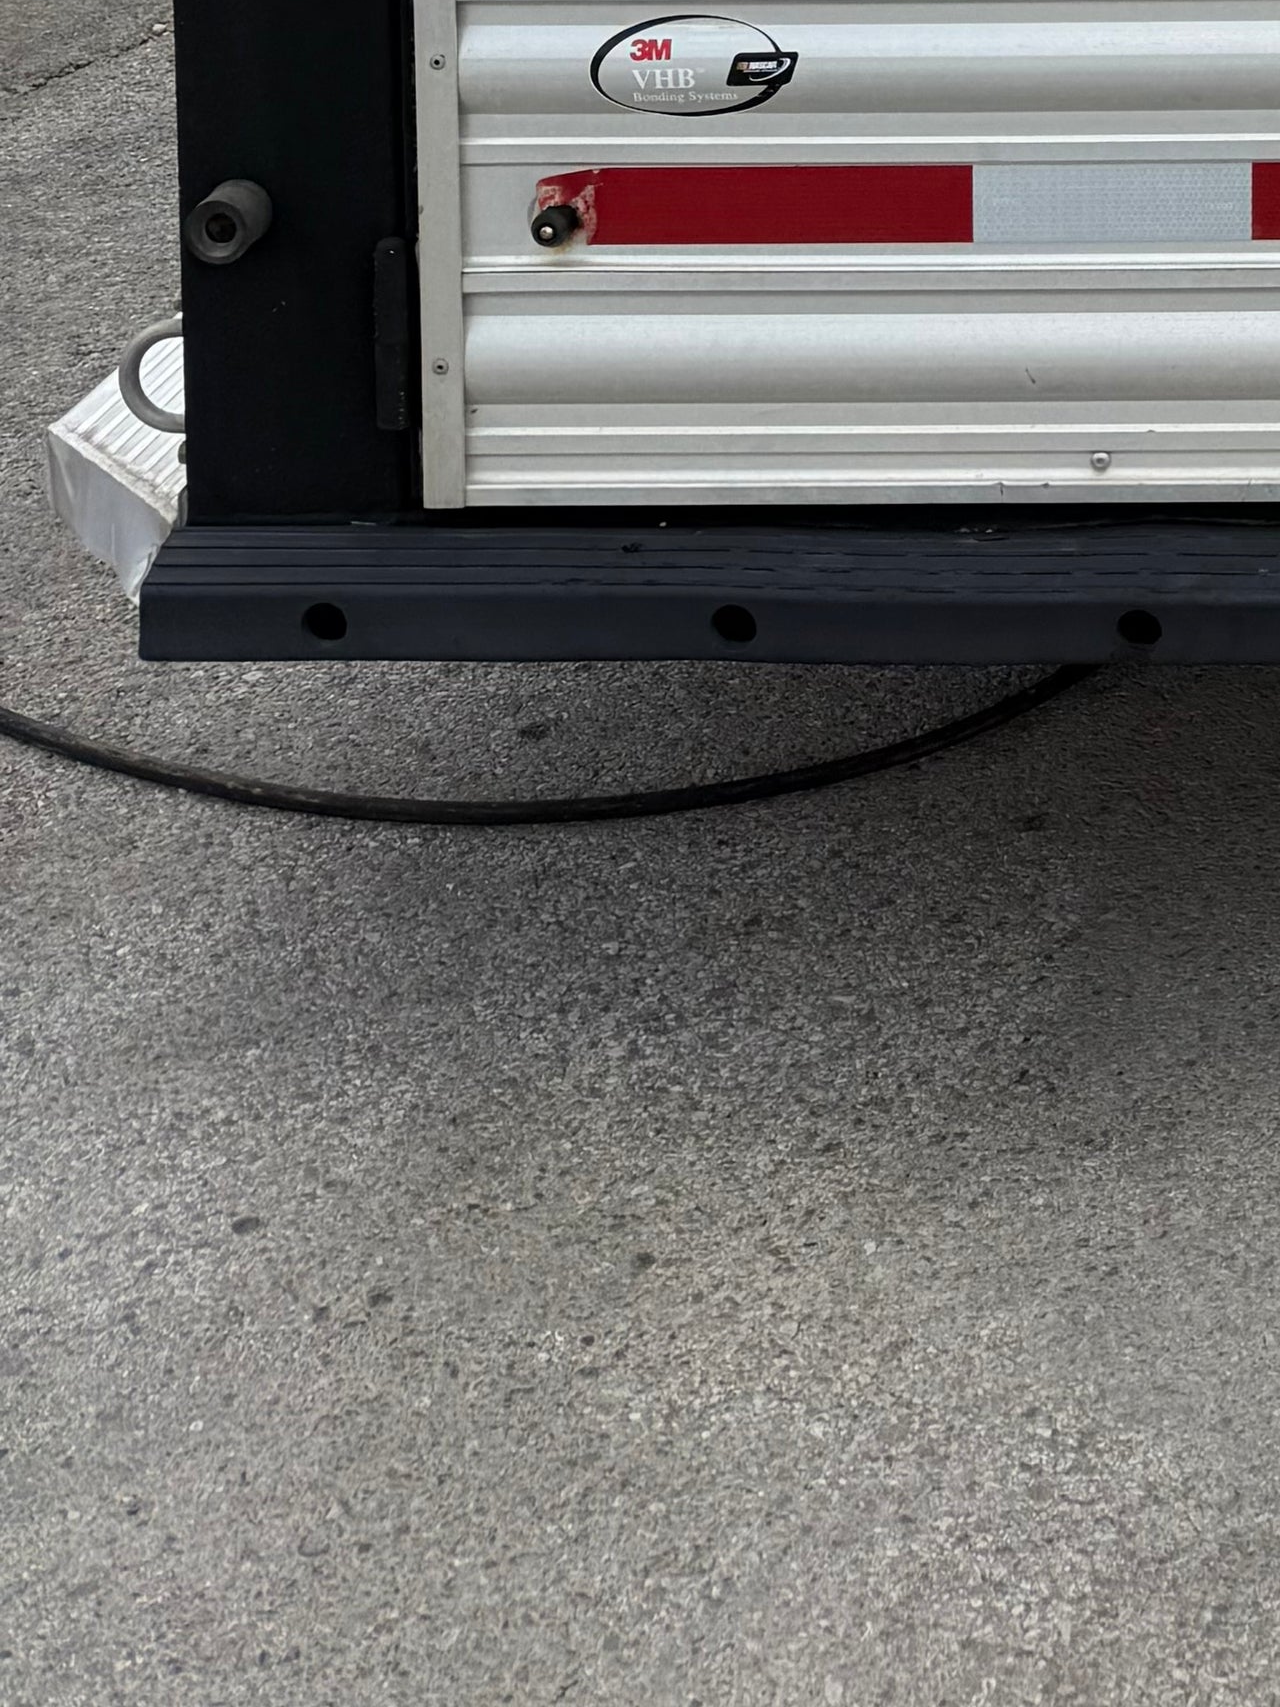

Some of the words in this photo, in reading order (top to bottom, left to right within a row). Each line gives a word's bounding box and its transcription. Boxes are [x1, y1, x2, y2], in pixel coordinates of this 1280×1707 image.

[630, 39, 673, 61] 3M
[632, 69, 696, 89] VHB
[633, 92, 685, 103] Bonding
[689, 91, 739, 103] Systems
